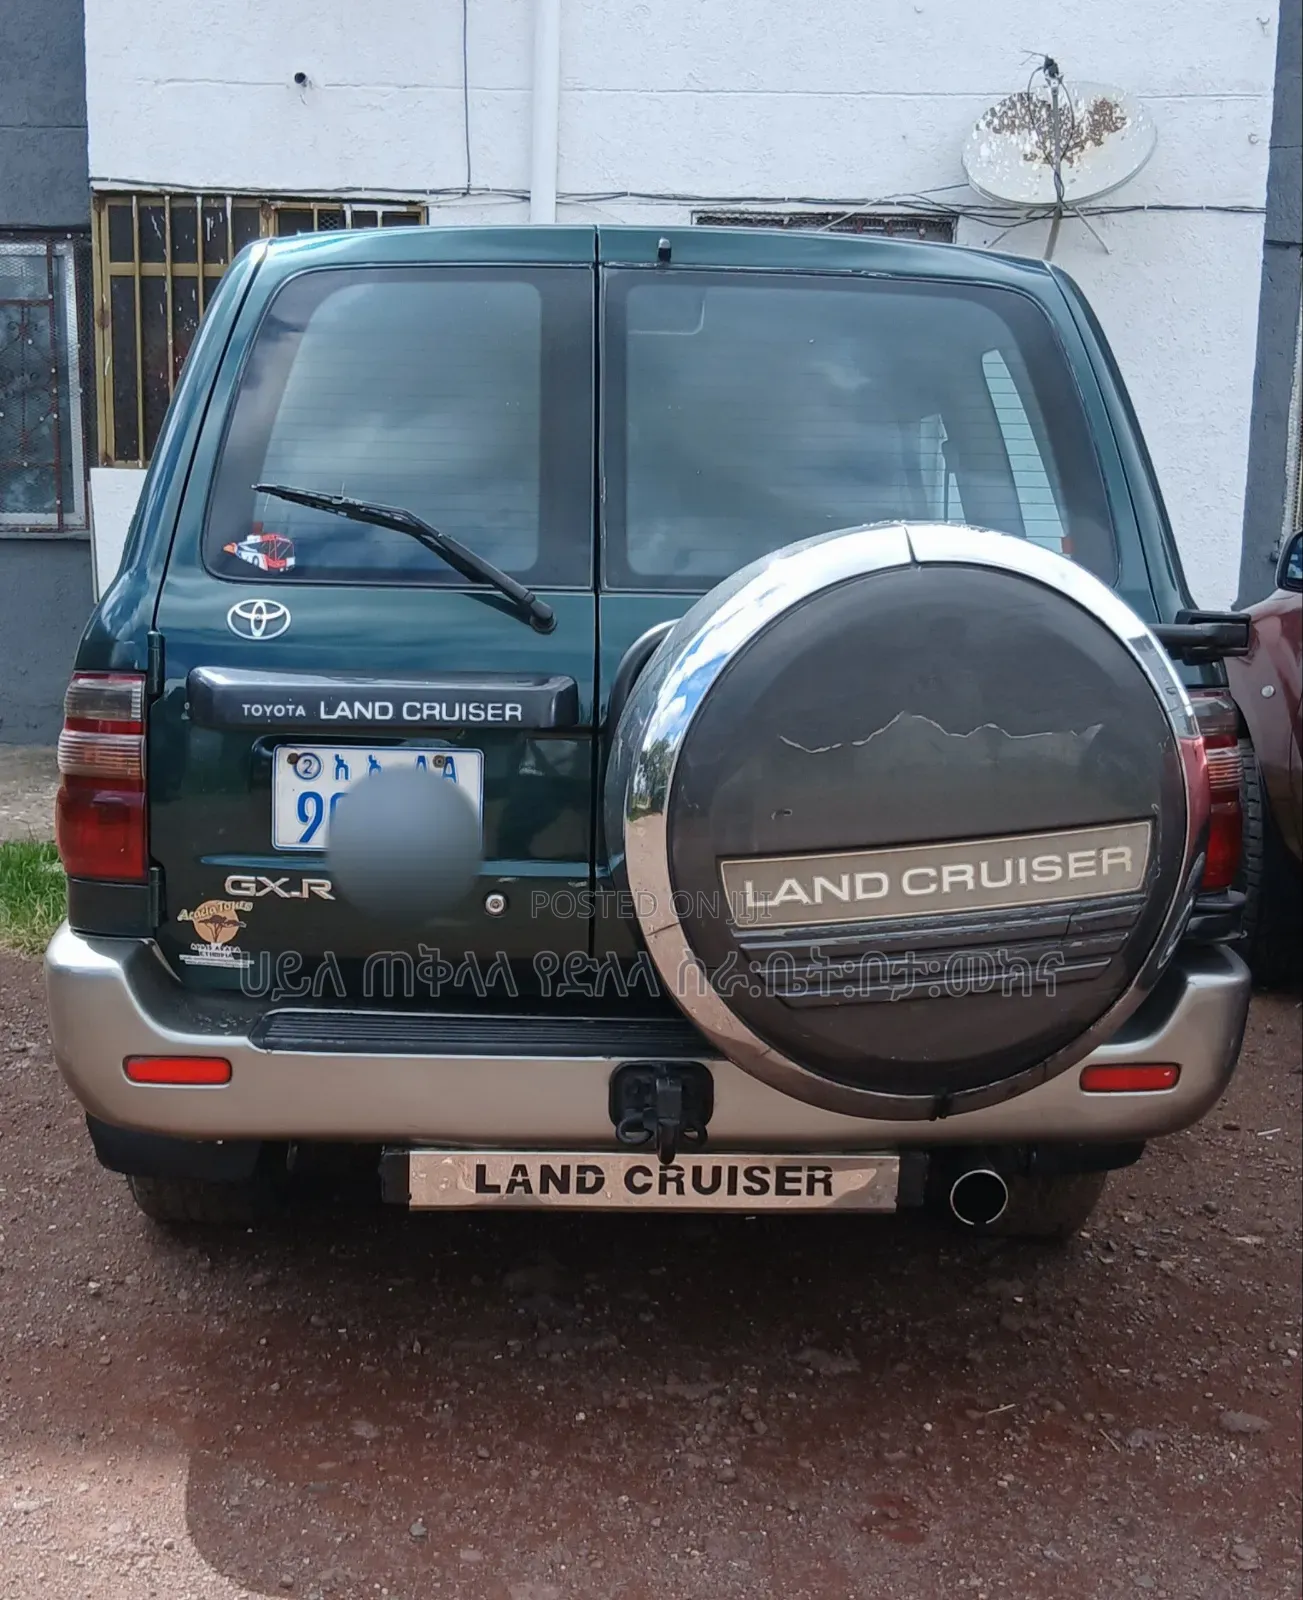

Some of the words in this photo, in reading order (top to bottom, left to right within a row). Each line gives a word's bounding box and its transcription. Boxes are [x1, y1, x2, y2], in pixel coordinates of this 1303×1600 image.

[242, 704, 306, 717] TOYOTA
[319, 701, 393, 720] LAND
[402, 702, 523, 722] CRUISER
[744, 869, 891, 909] LAND
[899, 846, 1133, 896] CRUISER
[475, 1163, 605, 1196] LAND
[623, 1164, 834, 1198] CRUISER
